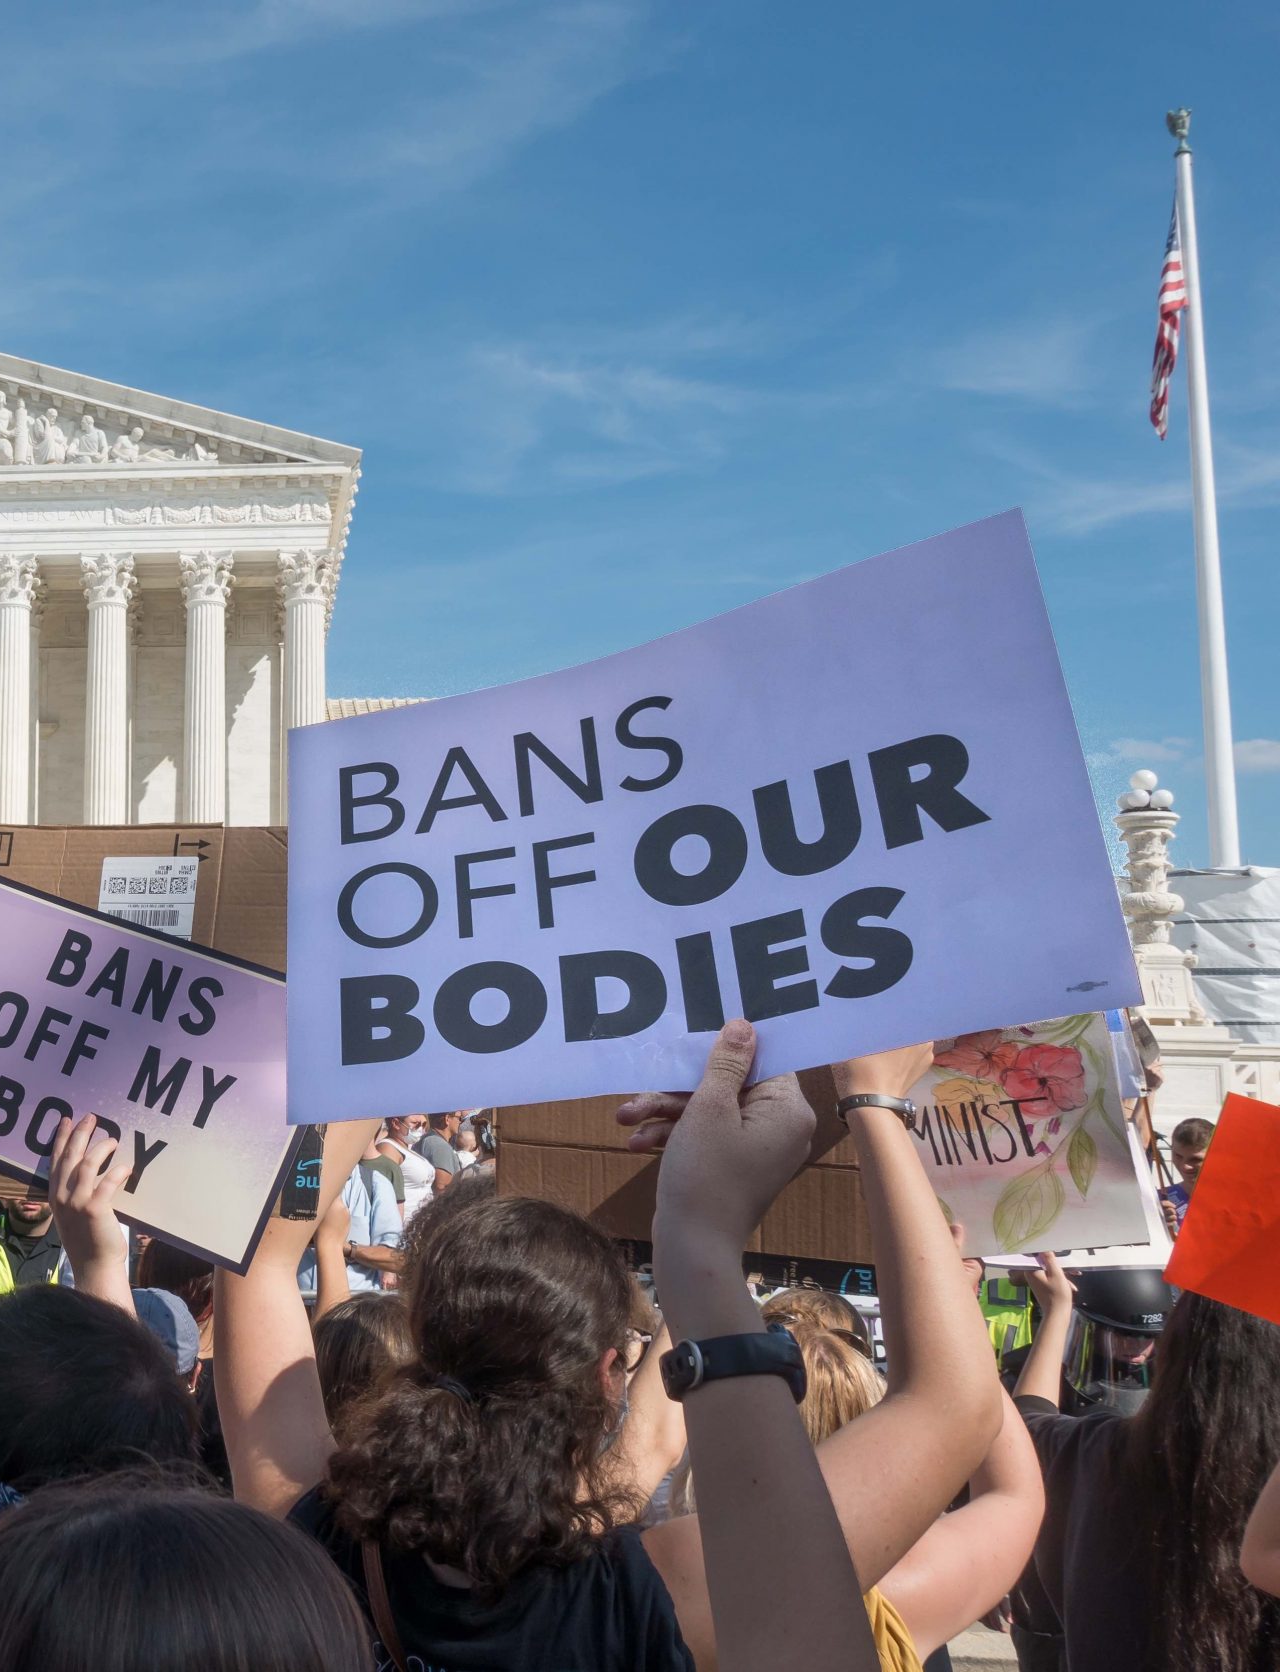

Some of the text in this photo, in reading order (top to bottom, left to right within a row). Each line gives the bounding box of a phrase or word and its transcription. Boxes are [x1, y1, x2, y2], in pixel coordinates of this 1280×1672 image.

[58, 508, 94, 522] LAW
[338, 695, 684, 845] BANS
[337, 734, 992, 949] OFF OUR
[46, 929, 223, 1036] BANS
[340, 886, 914, 1065] BODIES
[127, 1047, 237, 1129] MY
